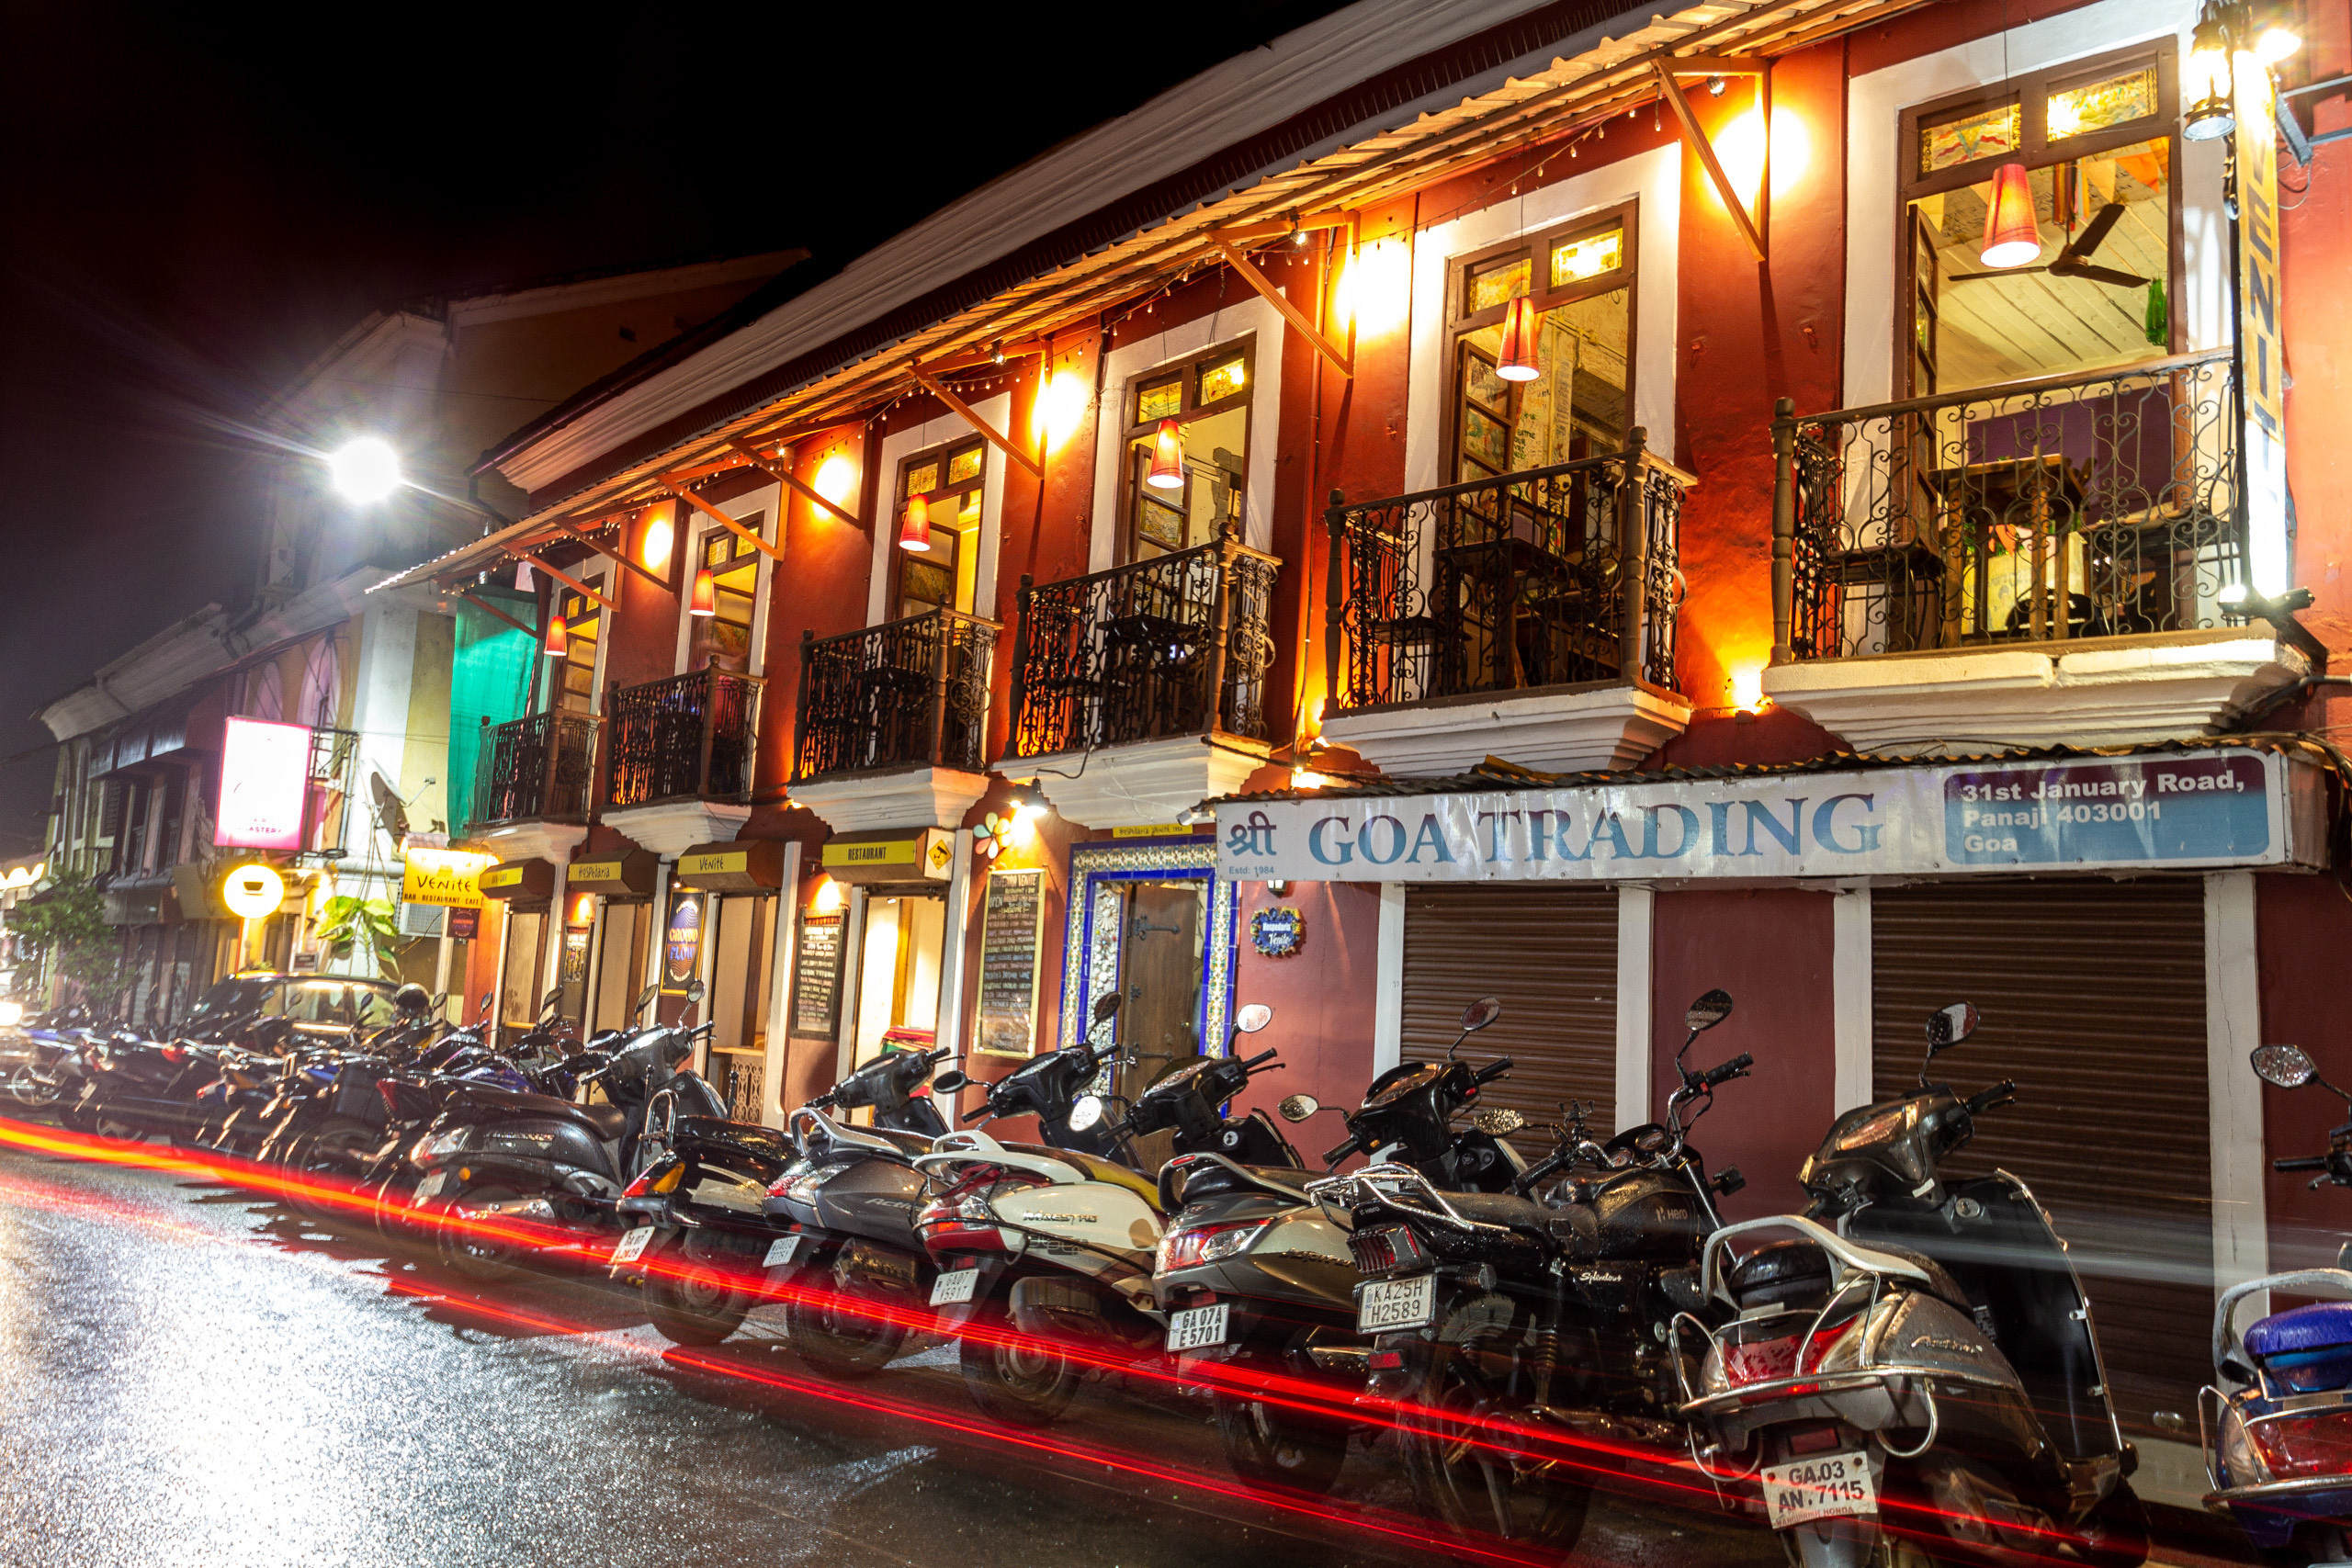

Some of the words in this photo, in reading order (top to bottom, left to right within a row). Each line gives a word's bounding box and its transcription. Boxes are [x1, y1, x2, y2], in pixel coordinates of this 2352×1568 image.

[1961, 783, 2021, 802] 31st
[2030, 779, 2147, 799] January
[2157, 770, 2245, 793] Road,
[1963, 807, 2048, 829] Panaji
[2057, 801, 2160, 823] 403001
[1226, 810, 1277, 856] श्री
[1308, 813, 1457, 865] GOA
[1476, 793, 1883, 863] TRADING
[848, 847, 887, 861] RESTAURANT
[1964, 834, 2018, 852] Goa
[1228, 866, 1250, 874] Estd:
[1254, 865, 1274, 874] 1984
[1667, 1209, 1688, 1220] Hero
[1374, 1278, 1424, 1303] KA25H
[1371, 1299, 1420, 1323] H2589
[1789, 1461, 1846, 1485] GA.03
[1823, 1506, 1855, 1517] HONDA
